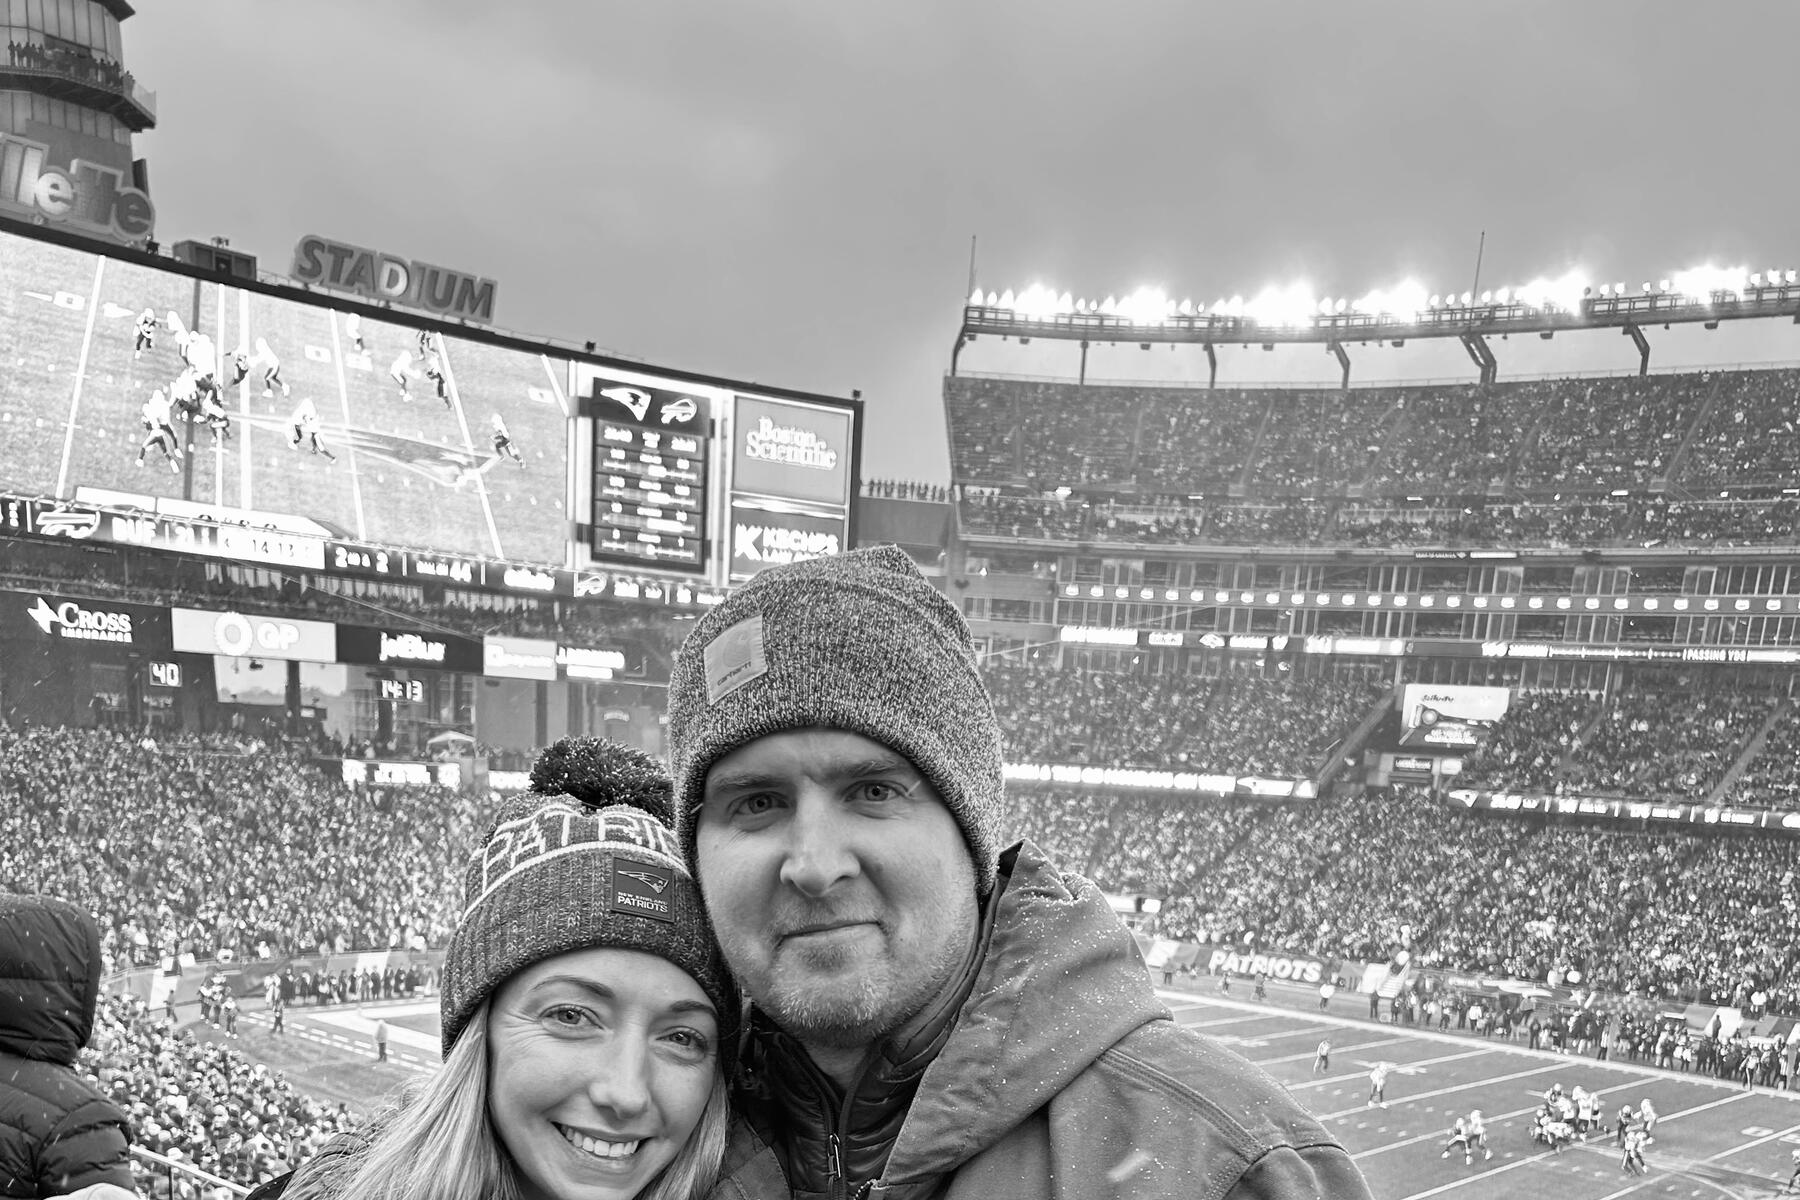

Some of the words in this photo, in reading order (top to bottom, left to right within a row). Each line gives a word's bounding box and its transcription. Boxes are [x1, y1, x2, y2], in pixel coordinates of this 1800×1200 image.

[297, 237, 495, 320] STADIUM
[152, 663, 180, 686] 40
[617, 895, 668, 913] PATRIOTS
[1208, 949, 1323, 983] PATRIOTS
